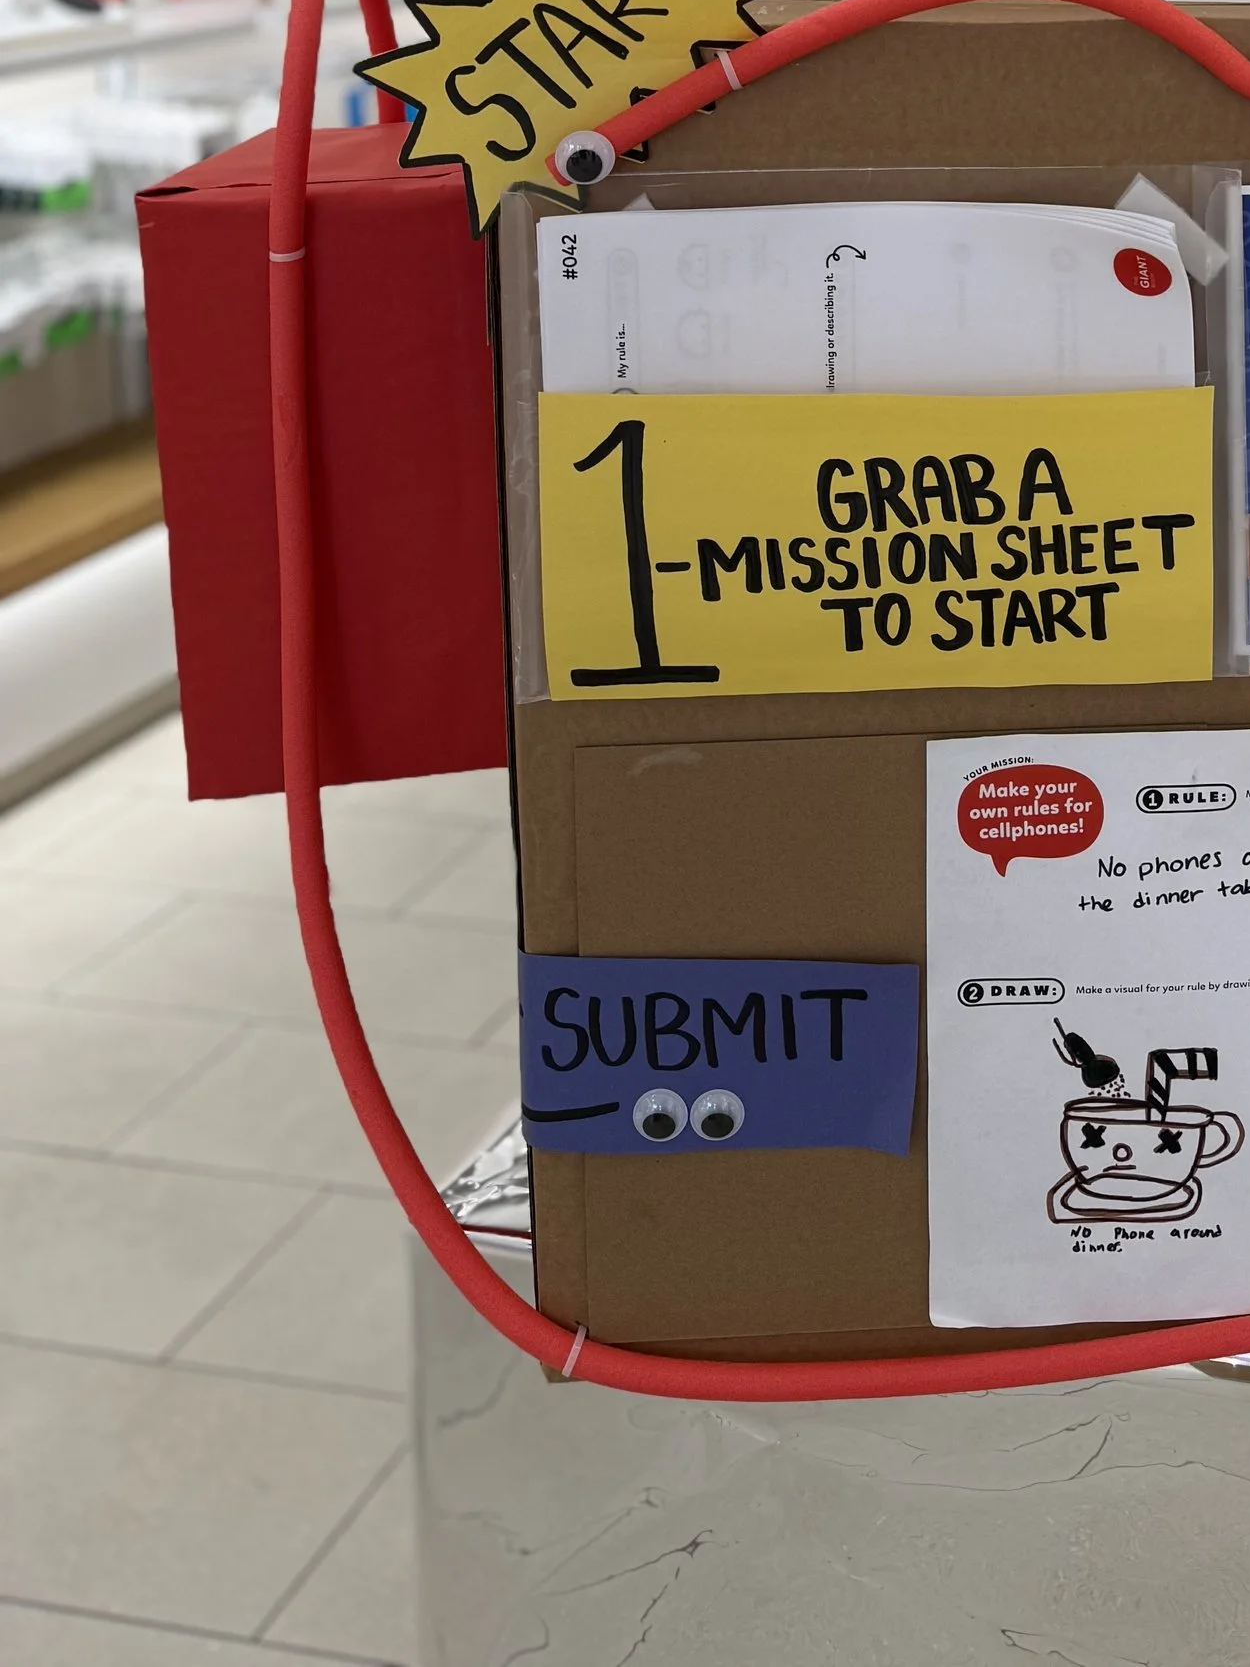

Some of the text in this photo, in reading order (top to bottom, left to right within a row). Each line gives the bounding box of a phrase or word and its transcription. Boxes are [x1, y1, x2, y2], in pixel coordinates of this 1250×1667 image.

[562, 234, 578, 280] #042
[824, 273, 836, 348] or describing it.
[816, 447, 1074, 533] GRAB A
[698, 513, 1194, 602] MISSION SHEET
[820, 582, 1120, 652] TO START
[963, 756, 1034, 782] YOUR MISSION:
[979, 781, 1077, 801] Make your
[1169, 791, 1227, 804] RULE:
[969, 797, 1092, 820] own rules for
[979, 818, 1084, 841] cellphones!
[1097, 856, 1126, 879] No
[1138, 850, 1222, 881] phones
[1078, 895, 1114, 912] the
[1132, 888, 1203, 909] dinner
[990, 984, 1058, 998] DRAW:
[1076, 985, 1102, 994] Make
[1114, 984, 1143, 993] visual
[1146, 984, 1160, 993] for
[1162, 985, 1184, 995] your
[1187, 982, 1206, 991] rule
[1208, 981, 1220, 992] by
[541, 987, 868, 1071] SUBMIT
[1170, 1224, 1222, 1239] around
